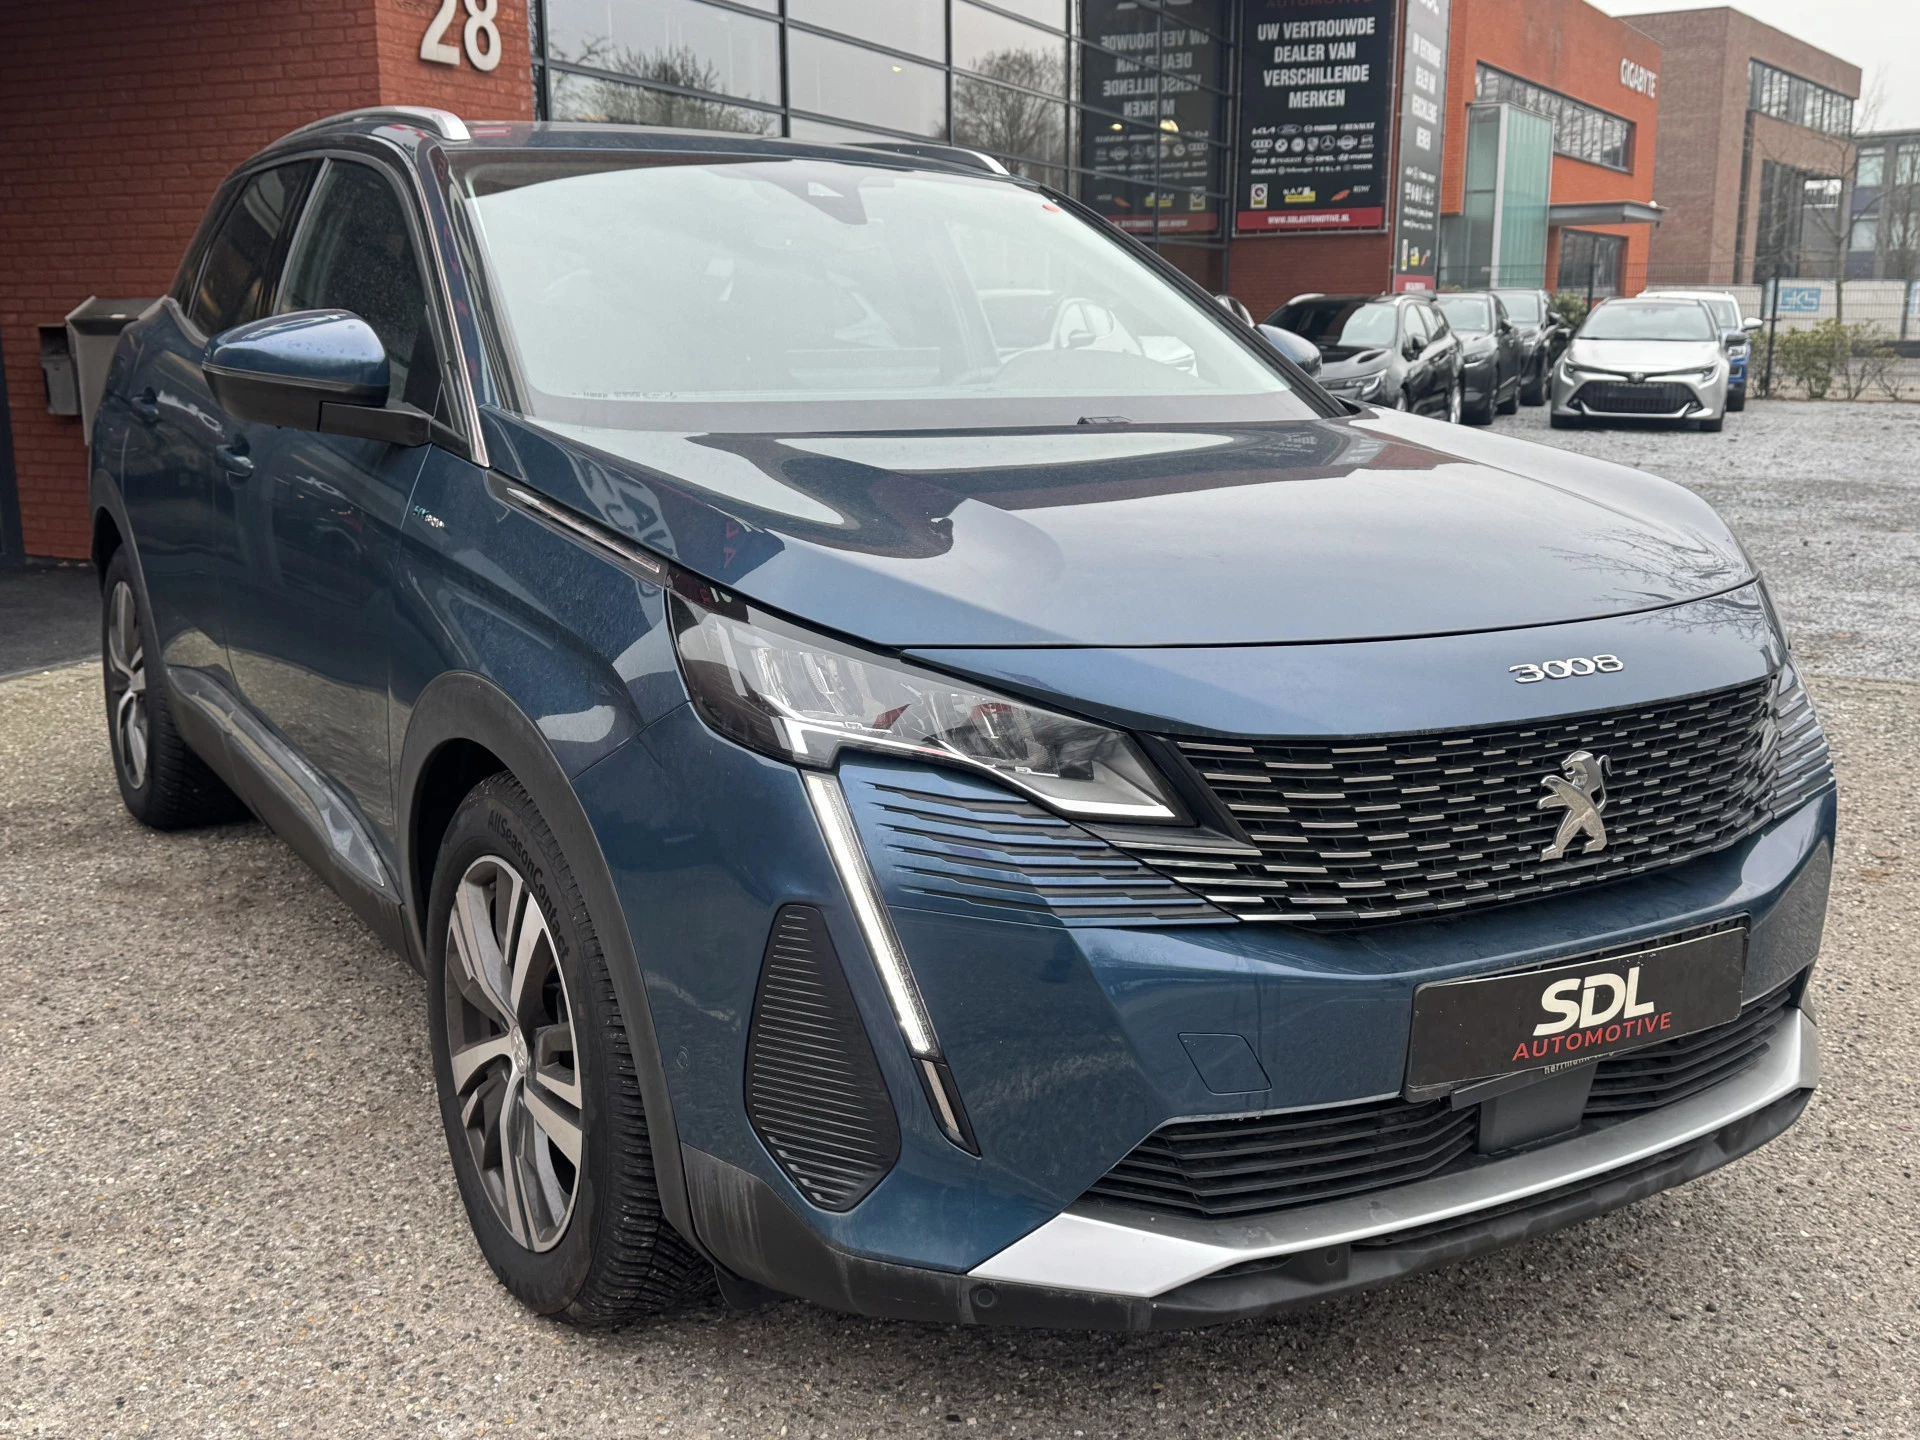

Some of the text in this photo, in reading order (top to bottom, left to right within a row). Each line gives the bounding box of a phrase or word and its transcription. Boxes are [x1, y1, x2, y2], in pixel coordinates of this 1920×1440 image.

[420, 0, 502, 71] 28
[1258, 17, 1376, 41] UW VERTROUWDE
[1274, 41, 1356, 63] DEALER VAN
[1263, 64, 1370, 87] VERSCHILLENDE
[1620, 58, 1657, 99] GIGABYTE
[1288, 89, 1345, 109] MERKEN
[1509, 654, 1624, 684] 3008
[488, 810, 570, 961] AllSeasonContact
[1532, 966, 1655, 1037] SDL
[1512, 1011, 1672, 1062] AUTOMOTIVE
